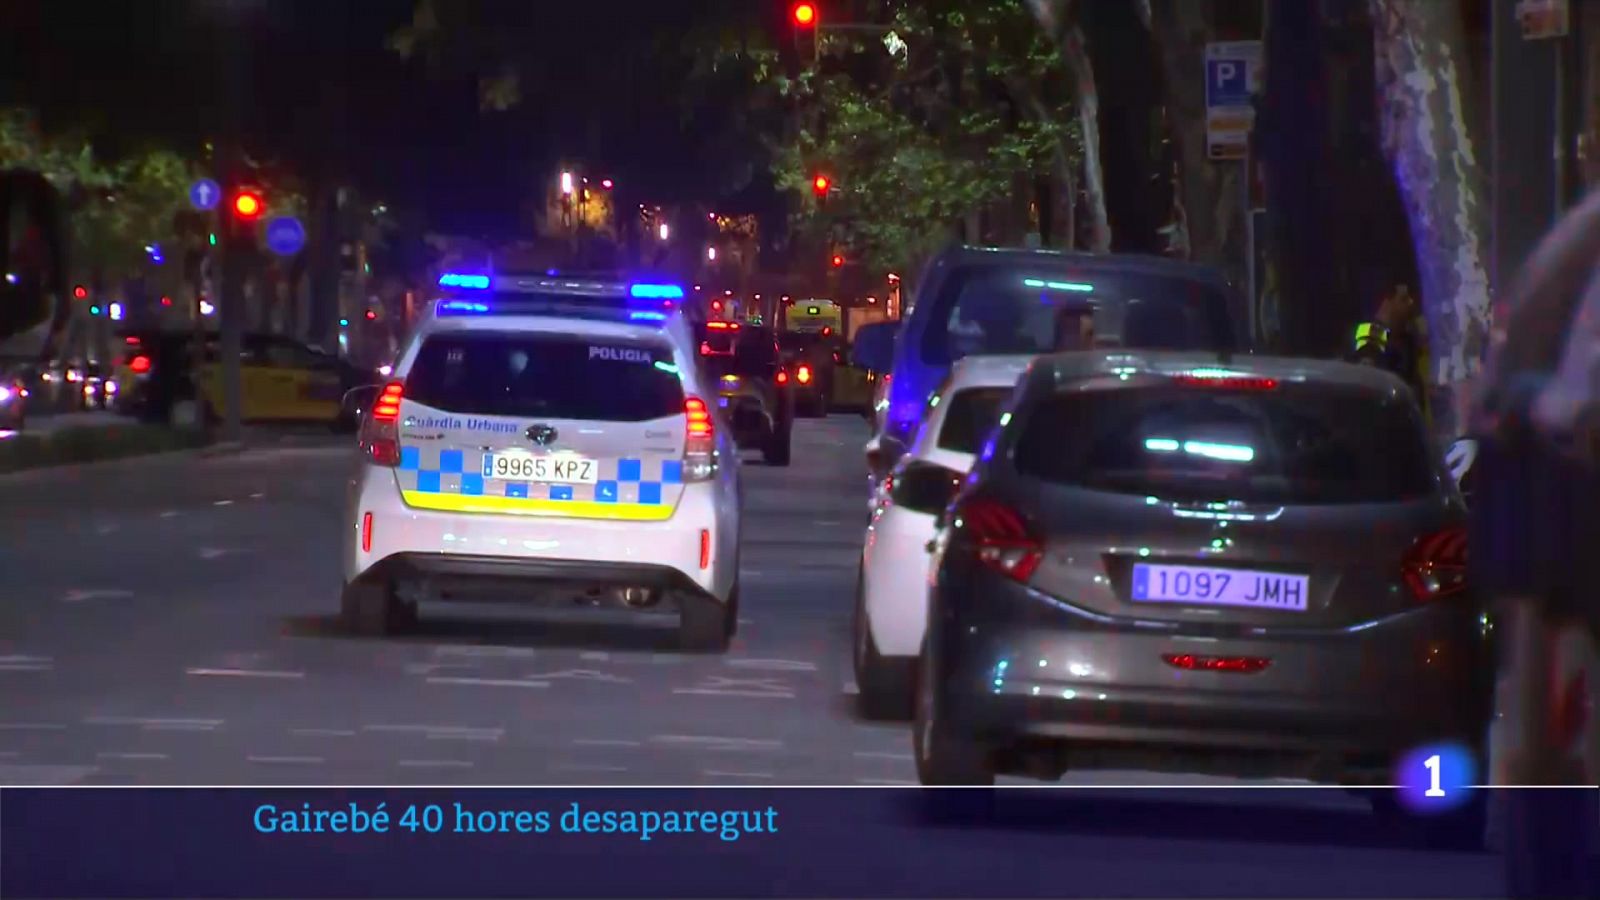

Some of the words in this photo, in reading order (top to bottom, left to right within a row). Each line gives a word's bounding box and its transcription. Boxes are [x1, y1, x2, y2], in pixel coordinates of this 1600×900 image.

[1218, 63, 1236, 89] P
[588, 346, 651, 363] POLICIA
[467, 418, 518, 433] Urbana
[496, 457, 547, 478] 9965
[554, 459, 592, 480] KPZ
[1159, 571, 1232, 599] 1097
[1244, 576, 1301, 605] JMH
